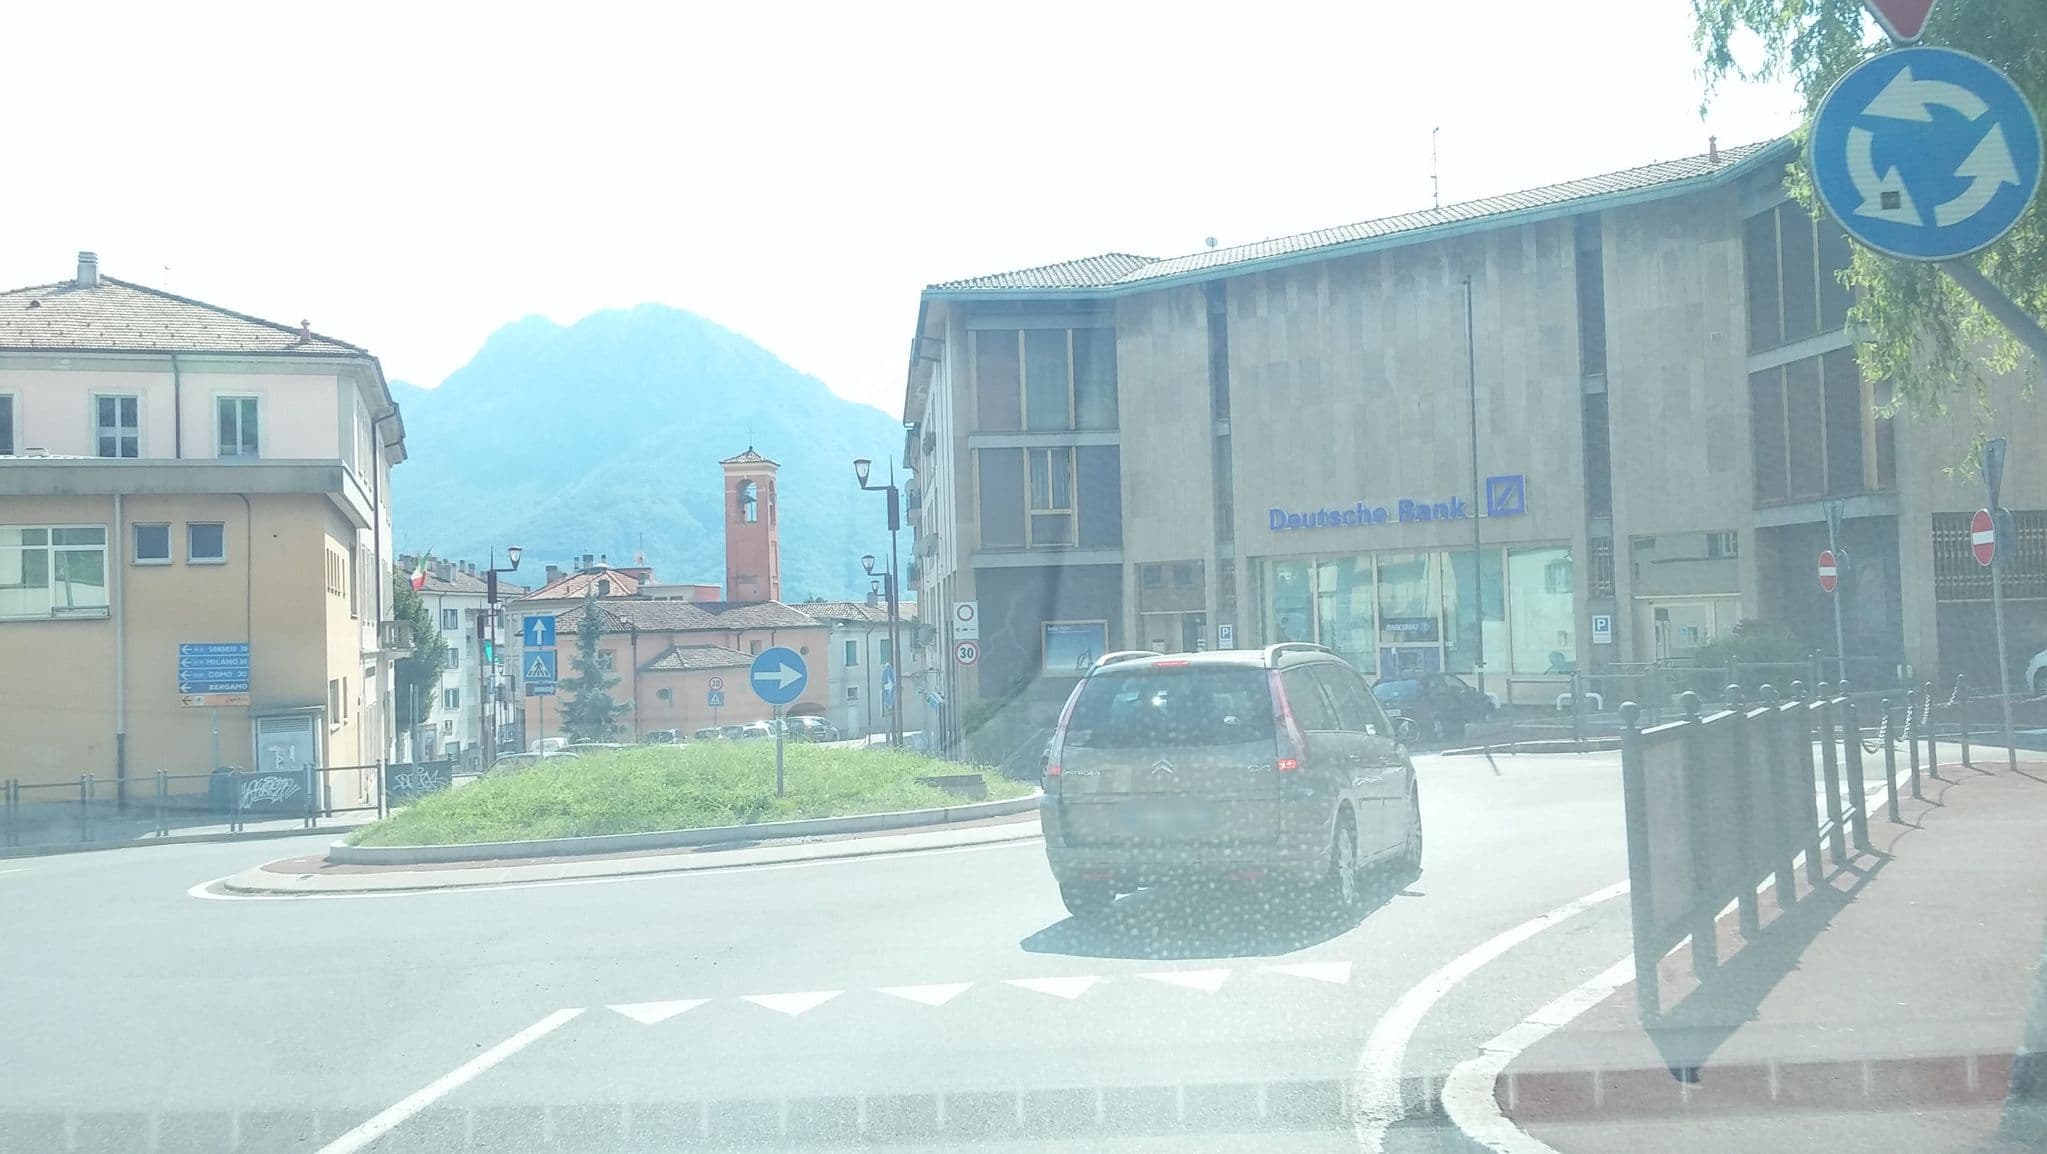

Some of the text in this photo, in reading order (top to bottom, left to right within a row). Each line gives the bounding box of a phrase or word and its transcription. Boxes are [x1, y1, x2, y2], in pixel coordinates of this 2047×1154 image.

[1269, 496, 1467, 531] Deutsche Bank
[960, 647, 974, 659] 30
